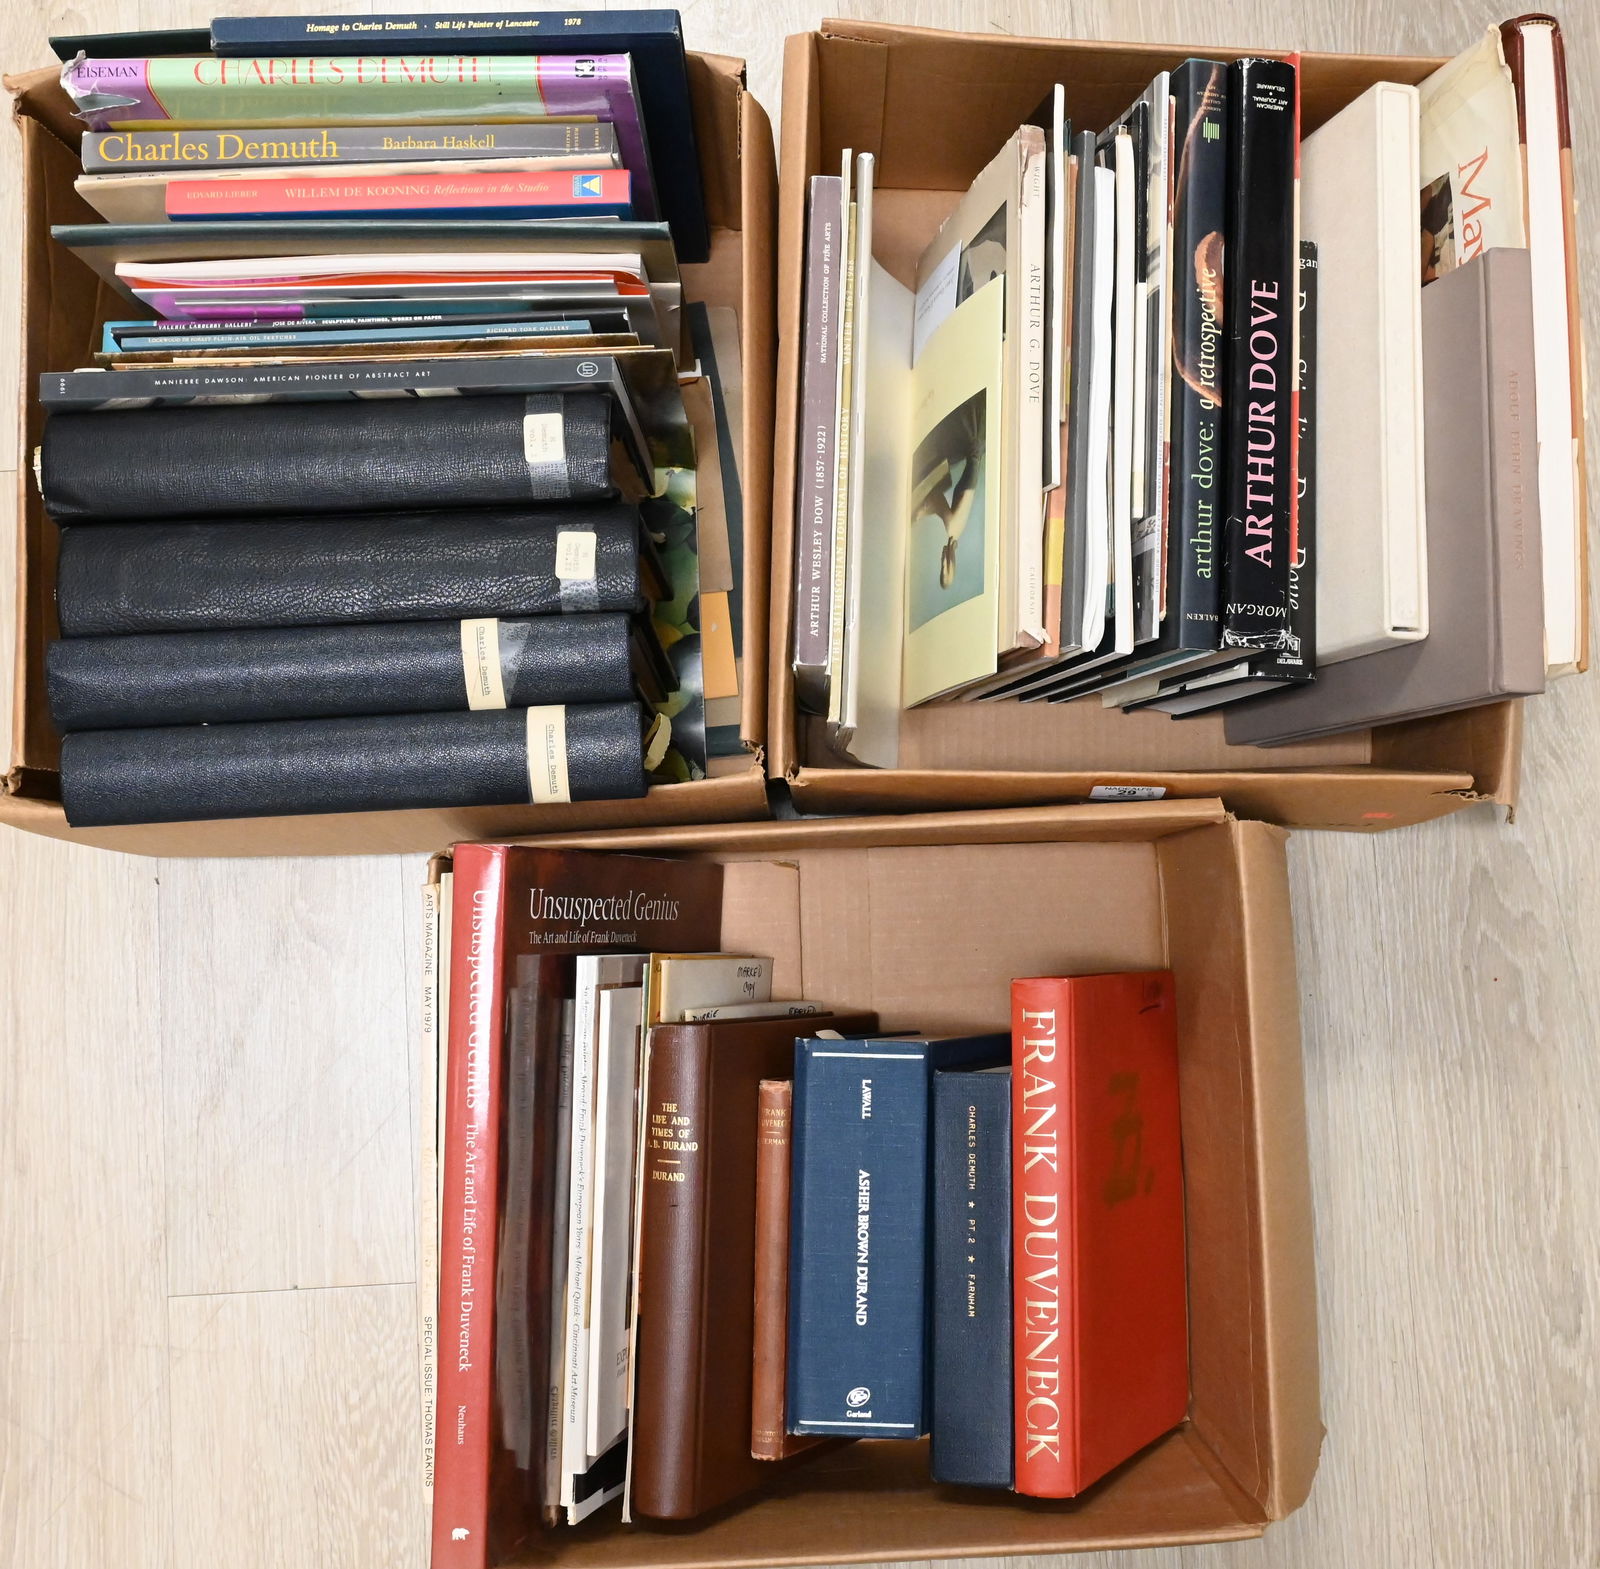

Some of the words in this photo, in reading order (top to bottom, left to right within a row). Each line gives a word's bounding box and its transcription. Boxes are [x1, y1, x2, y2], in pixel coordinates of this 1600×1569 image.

[305, 22, 340, 33] Homage
[341, 22, 350, 31] to
[352, 21, 383, 31] Charles
[385, 21, 418, 30] Demuth
[434, 20, 450, 29] Still
[451, 20, 466, 30] Life
[468, 20, 494, 29] Painter
[495, 19, 504, 30] of
[505, 18, 540, 28] Lancaster
[563, 18, 582, 26] 1978
[76, 66, 139, 79] EISEMAN
[194, 59, 345, 86] CHARLES
[357, 57, 493, 84] DEMUTH
[1252, 95, 1276, 104] JOURNAL
[1256, 83, 1286, 92] DELAWARE
[1276, 98, 1288, 106] ART
[1256, 103, 1284, 112] AMERICAN
[99, 132, 210, 162] Charles
[216, 130, 340, 162] Demuth
[383, 136, 438, 150] Barbara
[443, 134, 496, 150] Haskell
[186, 191, 223, 200] EDVARD
[285, 187, 341, 199] WILLEM
[344, 186, 362, 197] DE
[367, 184, 431, 197] KOONING
[433, 182, 484, 196] Reflections
[487, 183, 497, 193] in
[499, 182, 515, 193] the
[518, 182, 550, 193] Studio
[823, 264, 830, 274] OF
[822, 276, 830, 322] COLLECTION
[1029, 263, 1041, 329] ARTHUR
[1197, 268, 1222, 388] retrospective
[1249, 279, 1279, 392] DOVE
[820, 325, 828, 364] NATIONAL
[1029, 338, 1041, 353] G.
[155, 378, 200, 386] MANIERRE
[253, 375, 301, 383] AMERICAN
[306, 373, 344, 381] PIONEER
[365, 371, 410, 379] ABSTRACT
[415, 370, 431, 378] ART
[1028, 361, 1041, 404] DOVE
[1200, 399, 1216, 410] a
[840, 407, 850, 459] HISTORY
[1191, 421, 1215, 489] dove:
[1245, 400, 1277, 569] ARTHUR
[814, 495, 824, 525] DOW
[1189, 500, 1213, 579] arthur
[812, 530, 822, 580] WESLEY
[810, 586, 820, 637] ARTHUR
[1186, 613, 1219, 622] BALKEN
[1226, 603, 1288, 618] MORGAN
[478, 626, 486, 661] Charles
[481, 667, 490, 696] Demuth
[550, 764, 558, 794] Demuth
[425, 893, 433, 919] ARTS
[529, 888, 633, 927] Unsuspected
[634, 892, 680, 921] Genius
[424, 922, 433, 976] MAGAZINE
[529, 931, 541, 944] The
[543, 931, 554, 944] Art
[554, 931, 568, 944] and
[569, 931, 582, 944] Life
[582, 930, 590, 943] of
[590, 930, 609, 943] Frank
[424, 986, 432, 1008] MAY
[423, 1011, 432, 1033] 1979
[861, 1079, 872, 1120] LAWALL
[1022, 1007, 1058, 1174] FRANK
[652, 1114, 667, 1124] LIFE
[671, 1116, 691, 1126] AND
[662, 1103, 678, 1113] THE
[764, 1108, 786, 1117] RANK
[466, 1122, 479, 1148] The
[652, 1127, 674, 1137] TIMES
[678, 1129, 692, 1138] OF
[968, 1105, 976, 1148] CHARLES
[648, 1141, 660, 1150] .B.
[663, 1141, 699, 1152] DURAND
[464, 1152, 478, 1174] Art
[652, 1170, 686, 1182] DURAND
[968, 1153, 976, 1190] DEMUTH
[464, 1177, 477, 1203] and
[858, 1168, 871, 1214] ASHER
[463, 1208, 477, 1234] Life
[463, 1237, 476, 1252] of
[857, 1214, 870, 1264] BROWN
[461, 1254, 475, 1297] Frank
[574, 1255, 582, 1290] Michael
[572, 1291, 581, 1318] Quick
[855, 1266, 869, 1327] DURAND
[967, 1274, 976, 1317] FARNHAM
[424, 1316, 433, 1360] SPECIAL
[458, 1301, 473, 1372] Duveneck
[1024, 1191, 1060, 1464] DUVENECK
[571, 1322, 580, 1369] Cincinnati
[424, 1363, 433, 1396] ISSUE:
[571, 1371, 579, 1385] Art
[569, 1385, 579, 1424] Museum
[846, 1410, 872, 1418] Garland
[424, 1399, 433, 1445] THOMAS
[458, 1405, 467, 1445] Neuhaus
[424, 1448, 433, 1487] EAKINS
